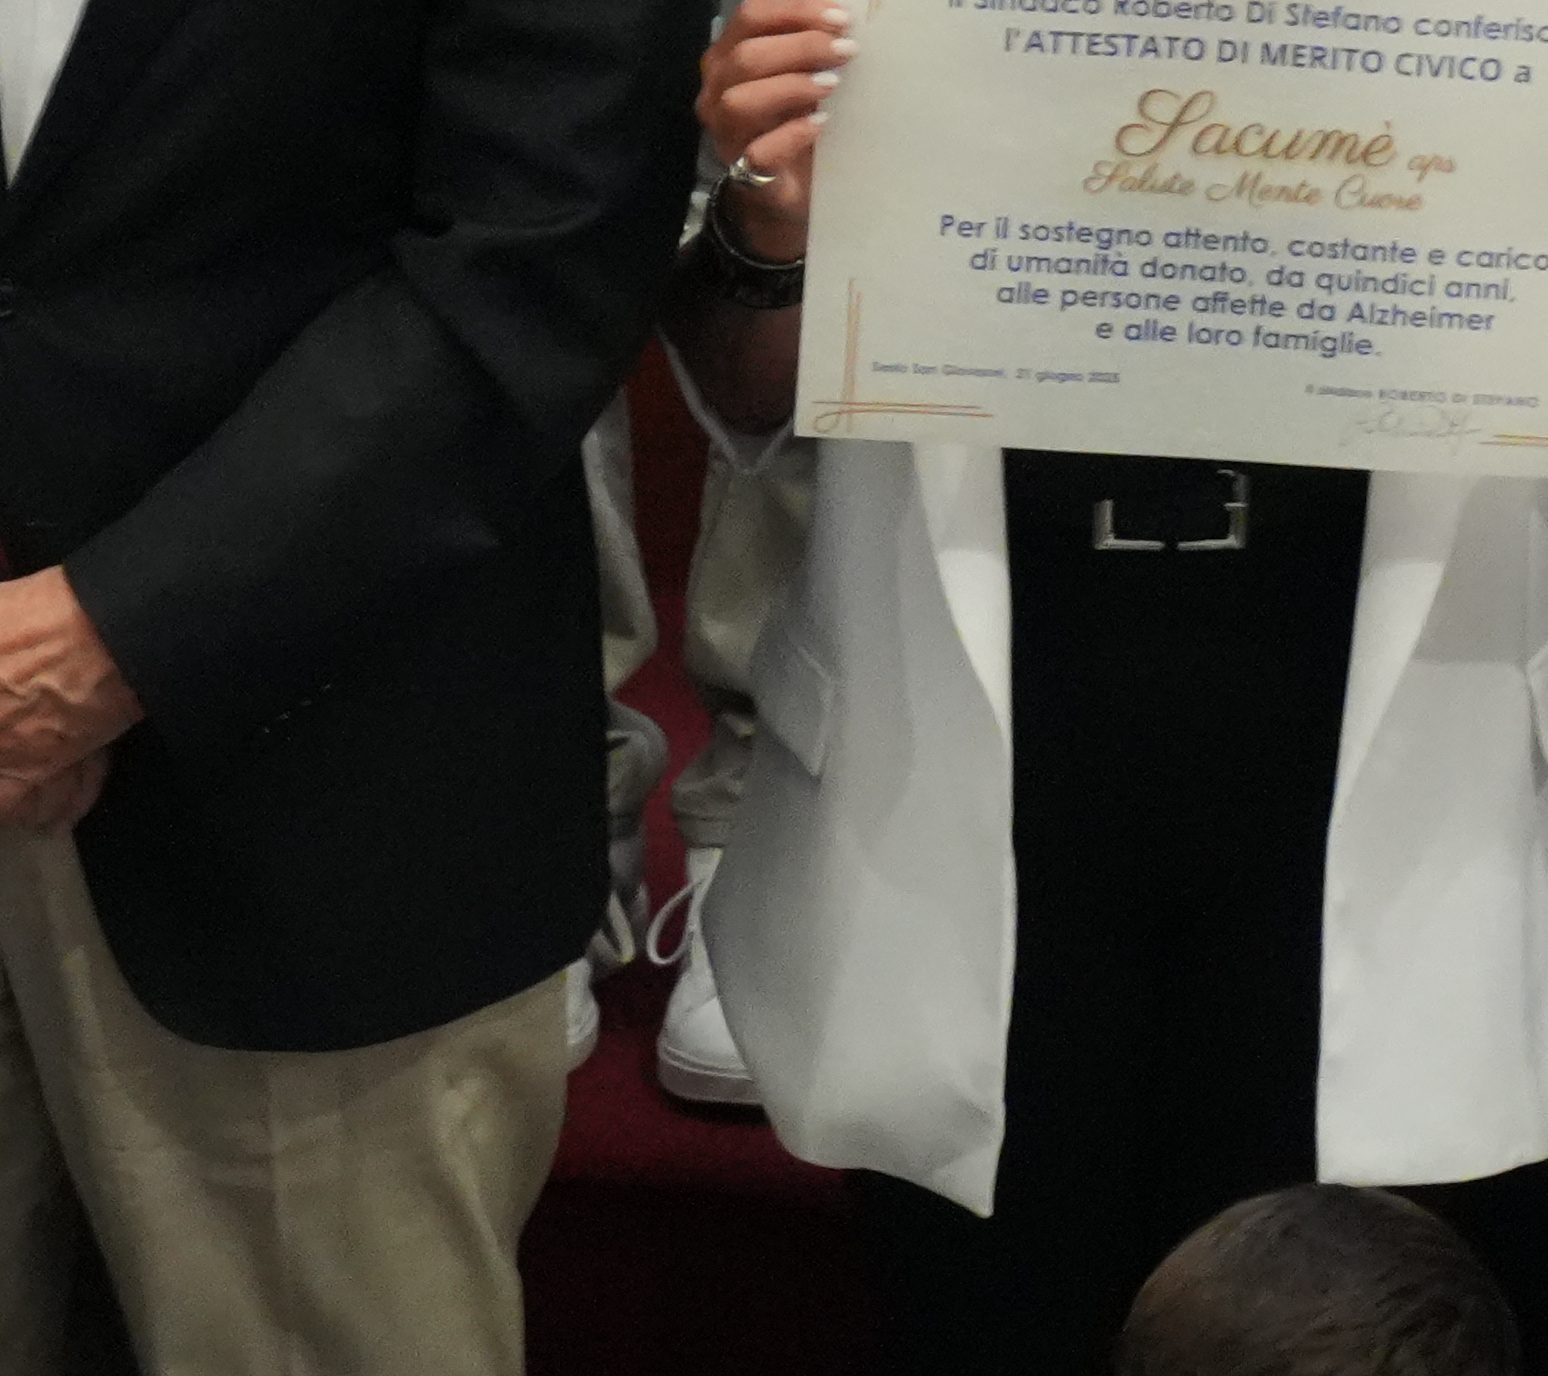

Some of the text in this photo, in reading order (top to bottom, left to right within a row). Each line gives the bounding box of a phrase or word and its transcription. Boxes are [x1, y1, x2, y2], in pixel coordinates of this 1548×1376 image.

[1246, 0, 1277, 25] Di
[1284, 3, 1403, 34] Stefano
[1004, 27, 1531, 84] l'ATTESTATO DI MERITO CIVICO a
[1114, 89, 1397, 168] Sacumè
[1081, 164, 1423, 212] Salute Mente Cuore
[940, 214, 987, 238] Per
[995, 216, 1009, 239] il
[1019, 221, 1153, 250] sostegno
[1162, 226, 1277, 257] attento,
[1286, 238, 1417, 264] costante
[1427, 248, 1446, 266] e
[969, 249, 1515, 303] di umanità donato, da quindici anni,
[996, 281, 1495, 331] alle persone affette da Alzheimer
[1095, 319, 1381, 359] e alle loro famiglie.
